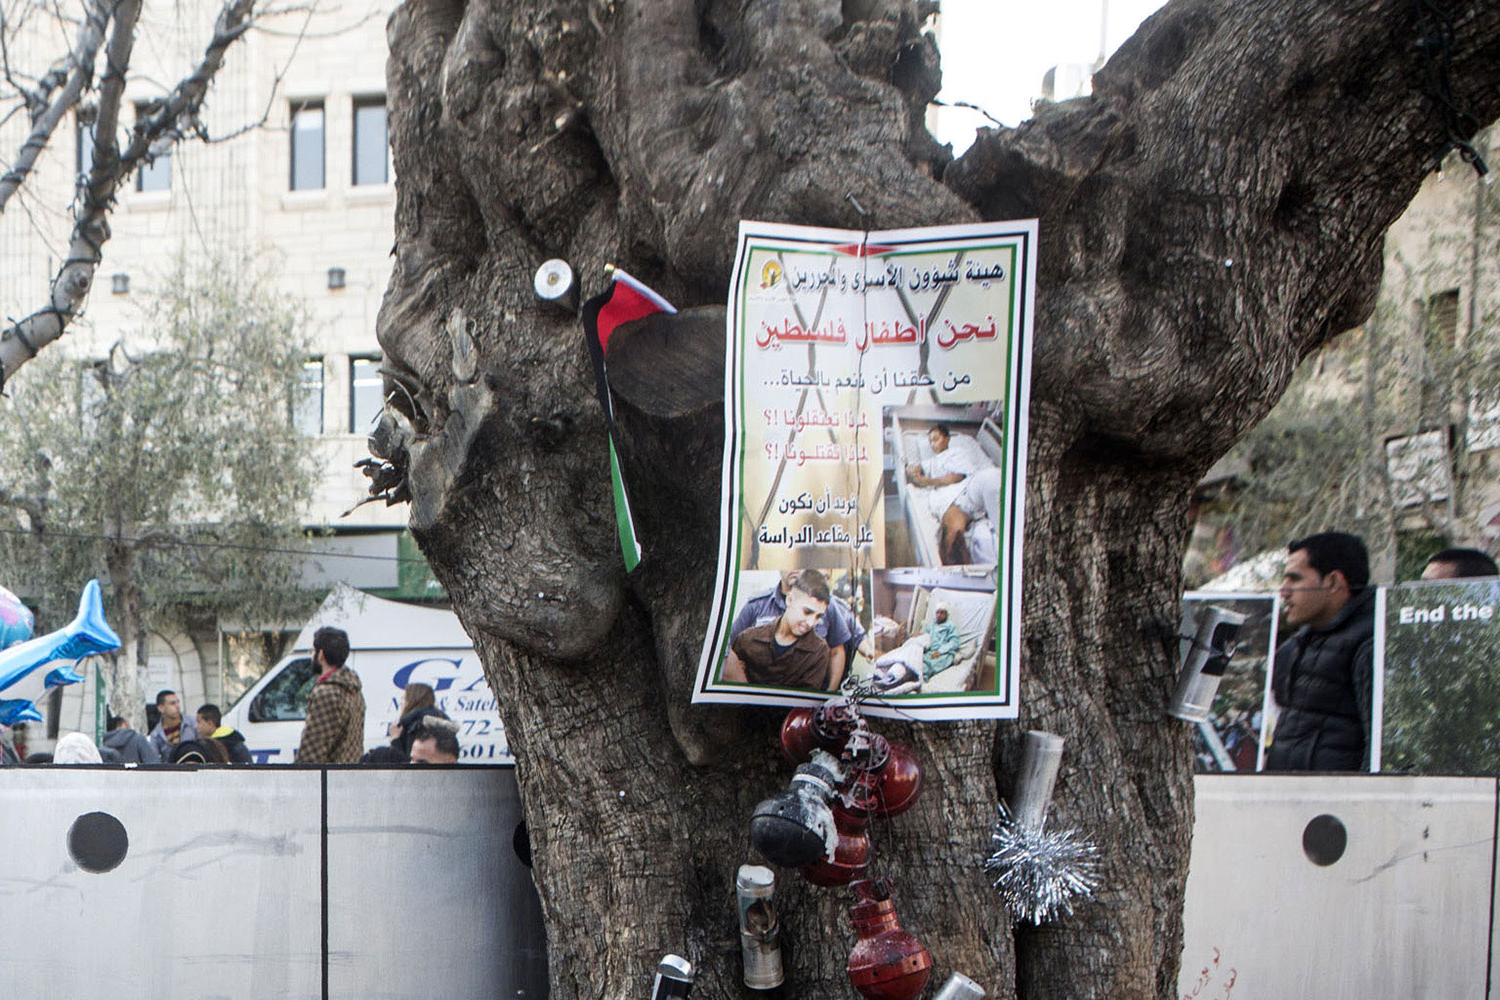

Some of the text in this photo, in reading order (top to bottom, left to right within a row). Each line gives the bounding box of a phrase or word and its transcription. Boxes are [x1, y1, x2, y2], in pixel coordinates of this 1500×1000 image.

[852, 261, 903, 291] الأسرى
[910, 258, 958, 290] شؤون
[756, 313, 996, 351] نحن أطفال فلسطين
[871, 367, 887, 394] أن
[893, 368, 935, 387] حقنا
[943, 371, 971, 391] من
[778, 486, 857, 515] نريد أن نكون
[759, 525, 874, 549] على مقاعد الدراسة
[1399, 602, 1493, 625] End the
